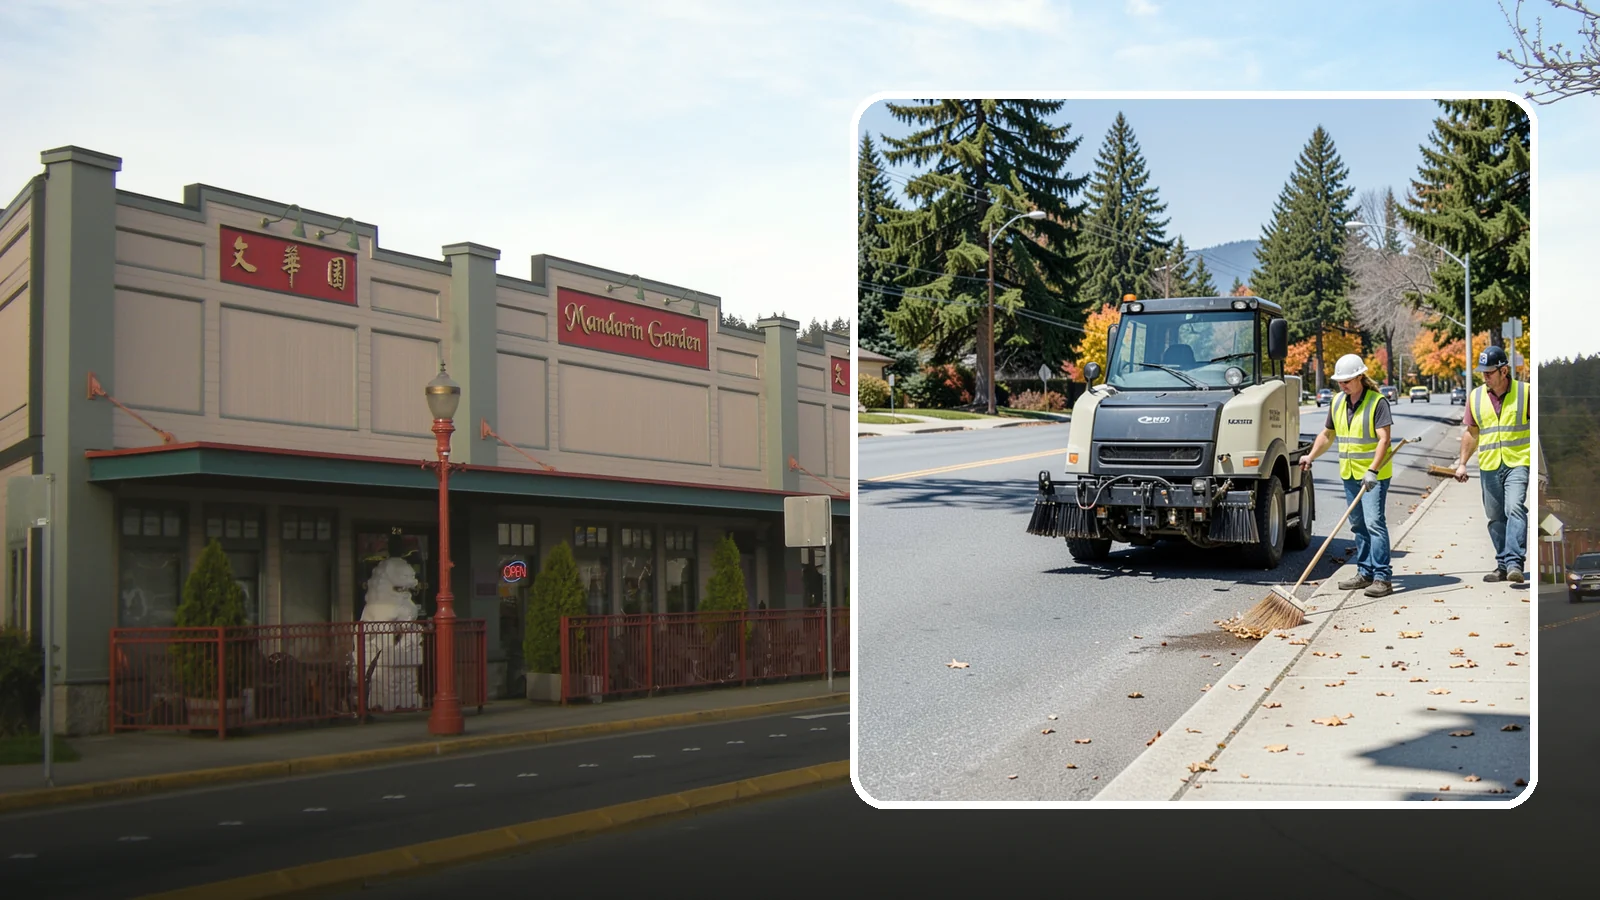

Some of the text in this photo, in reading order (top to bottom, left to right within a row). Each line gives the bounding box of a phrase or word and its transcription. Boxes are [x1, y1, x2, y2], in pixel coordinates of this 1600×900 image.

[231, 235, 346, 291] 文華園
[564, 302, 702, 352] Mandarin Garden
[503, 565, 527, 578] OPEN
